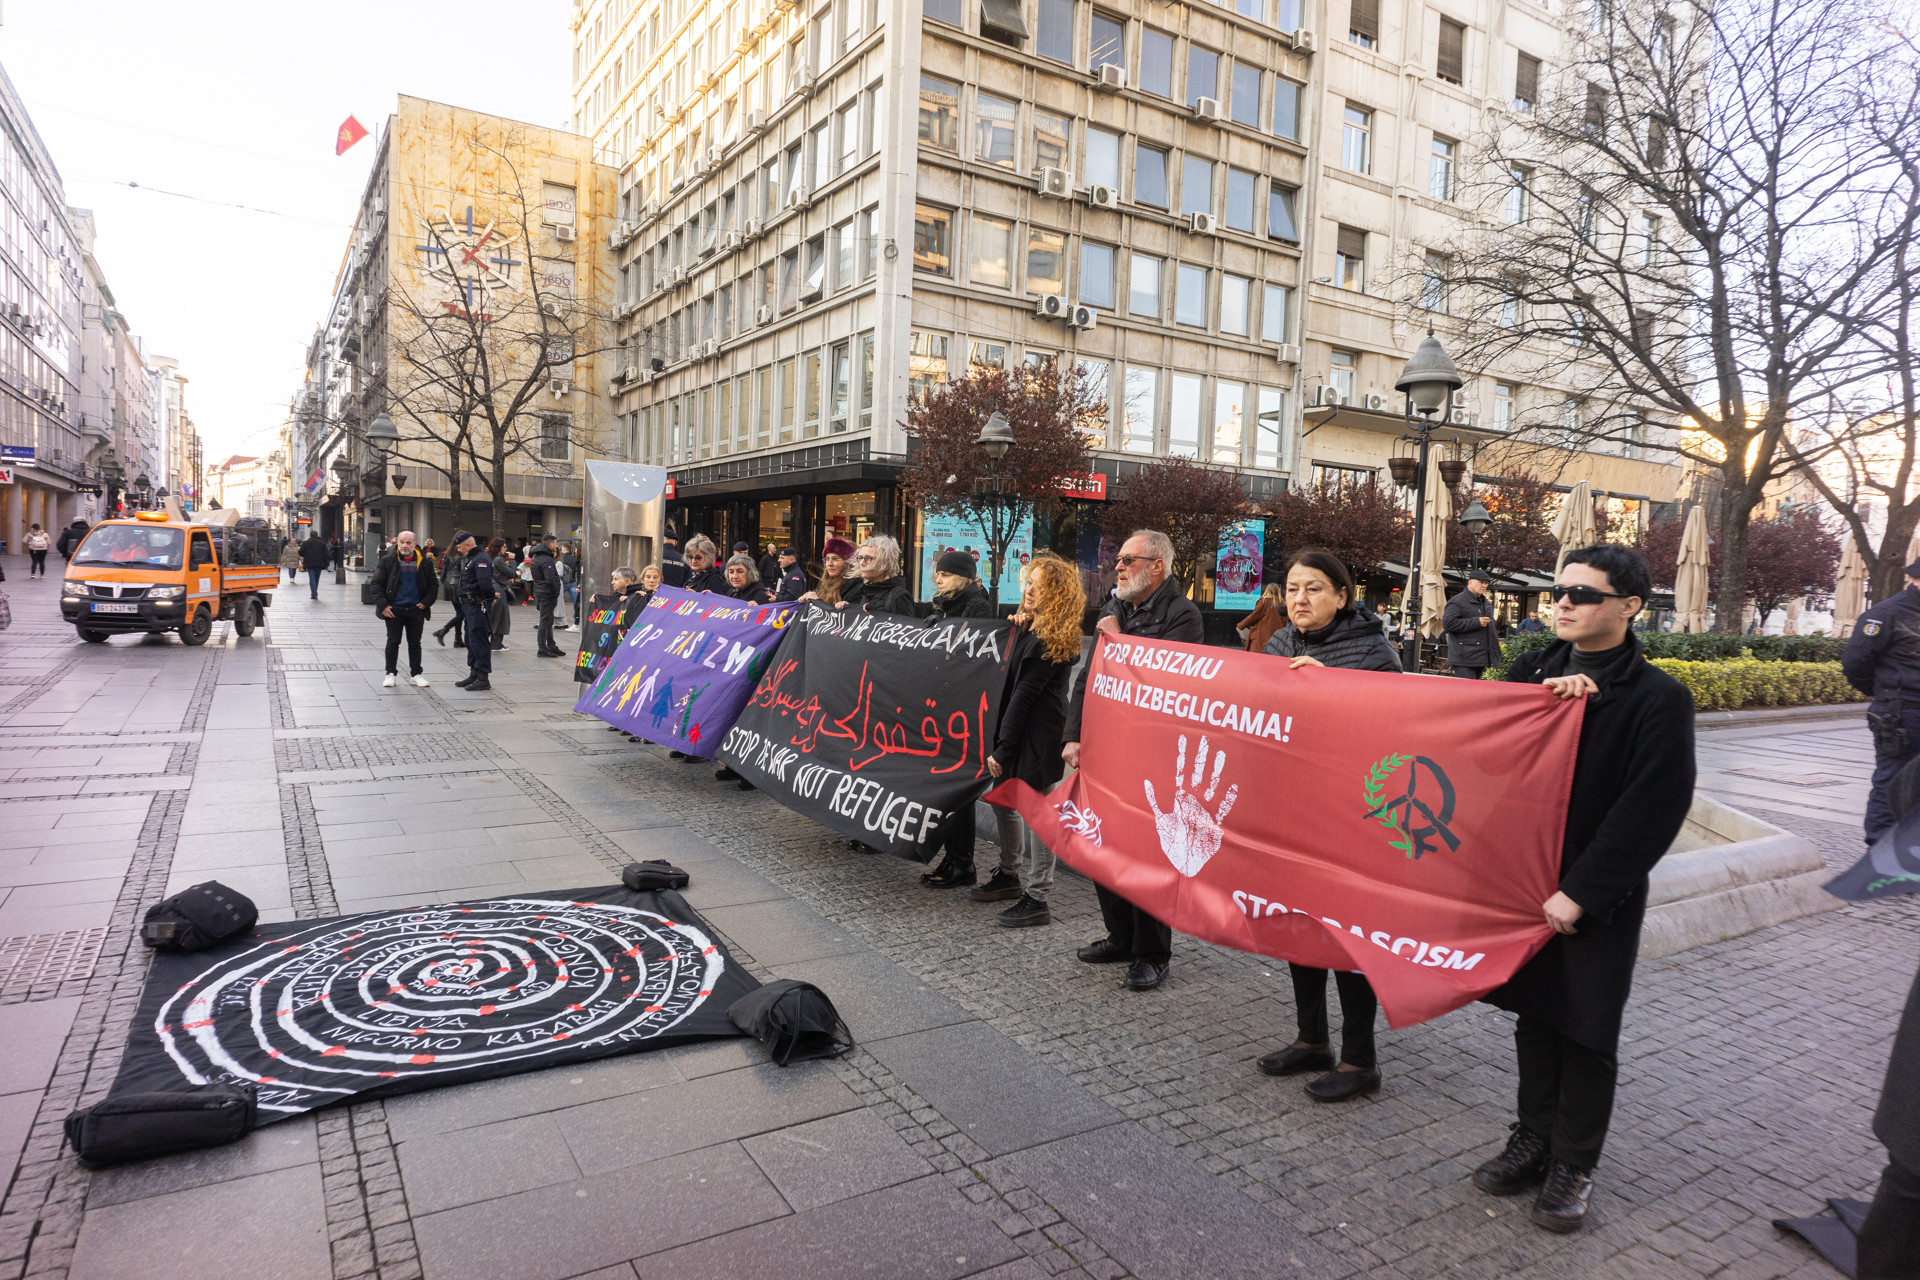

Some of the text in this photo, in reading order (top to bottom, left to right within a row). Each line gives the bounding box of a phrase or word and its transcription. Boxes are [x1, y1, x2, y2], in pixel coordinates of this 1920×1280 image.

[1102, 642, 1225, 680] STOP RASIZMU
[1092, 673, 1293, 743] PREMA IZBEGLICAMA!
[722, 726, 760, 765] STOP
[793, 762, 843, 800] NOT
[541, 936, 599, 989] KONGO
[636, 961, 670, 1002] LIBAN
[321, 999, 621, 1050] NAGORNO KARABAH
[356, 1008, 468, 1029] LIBIJA
